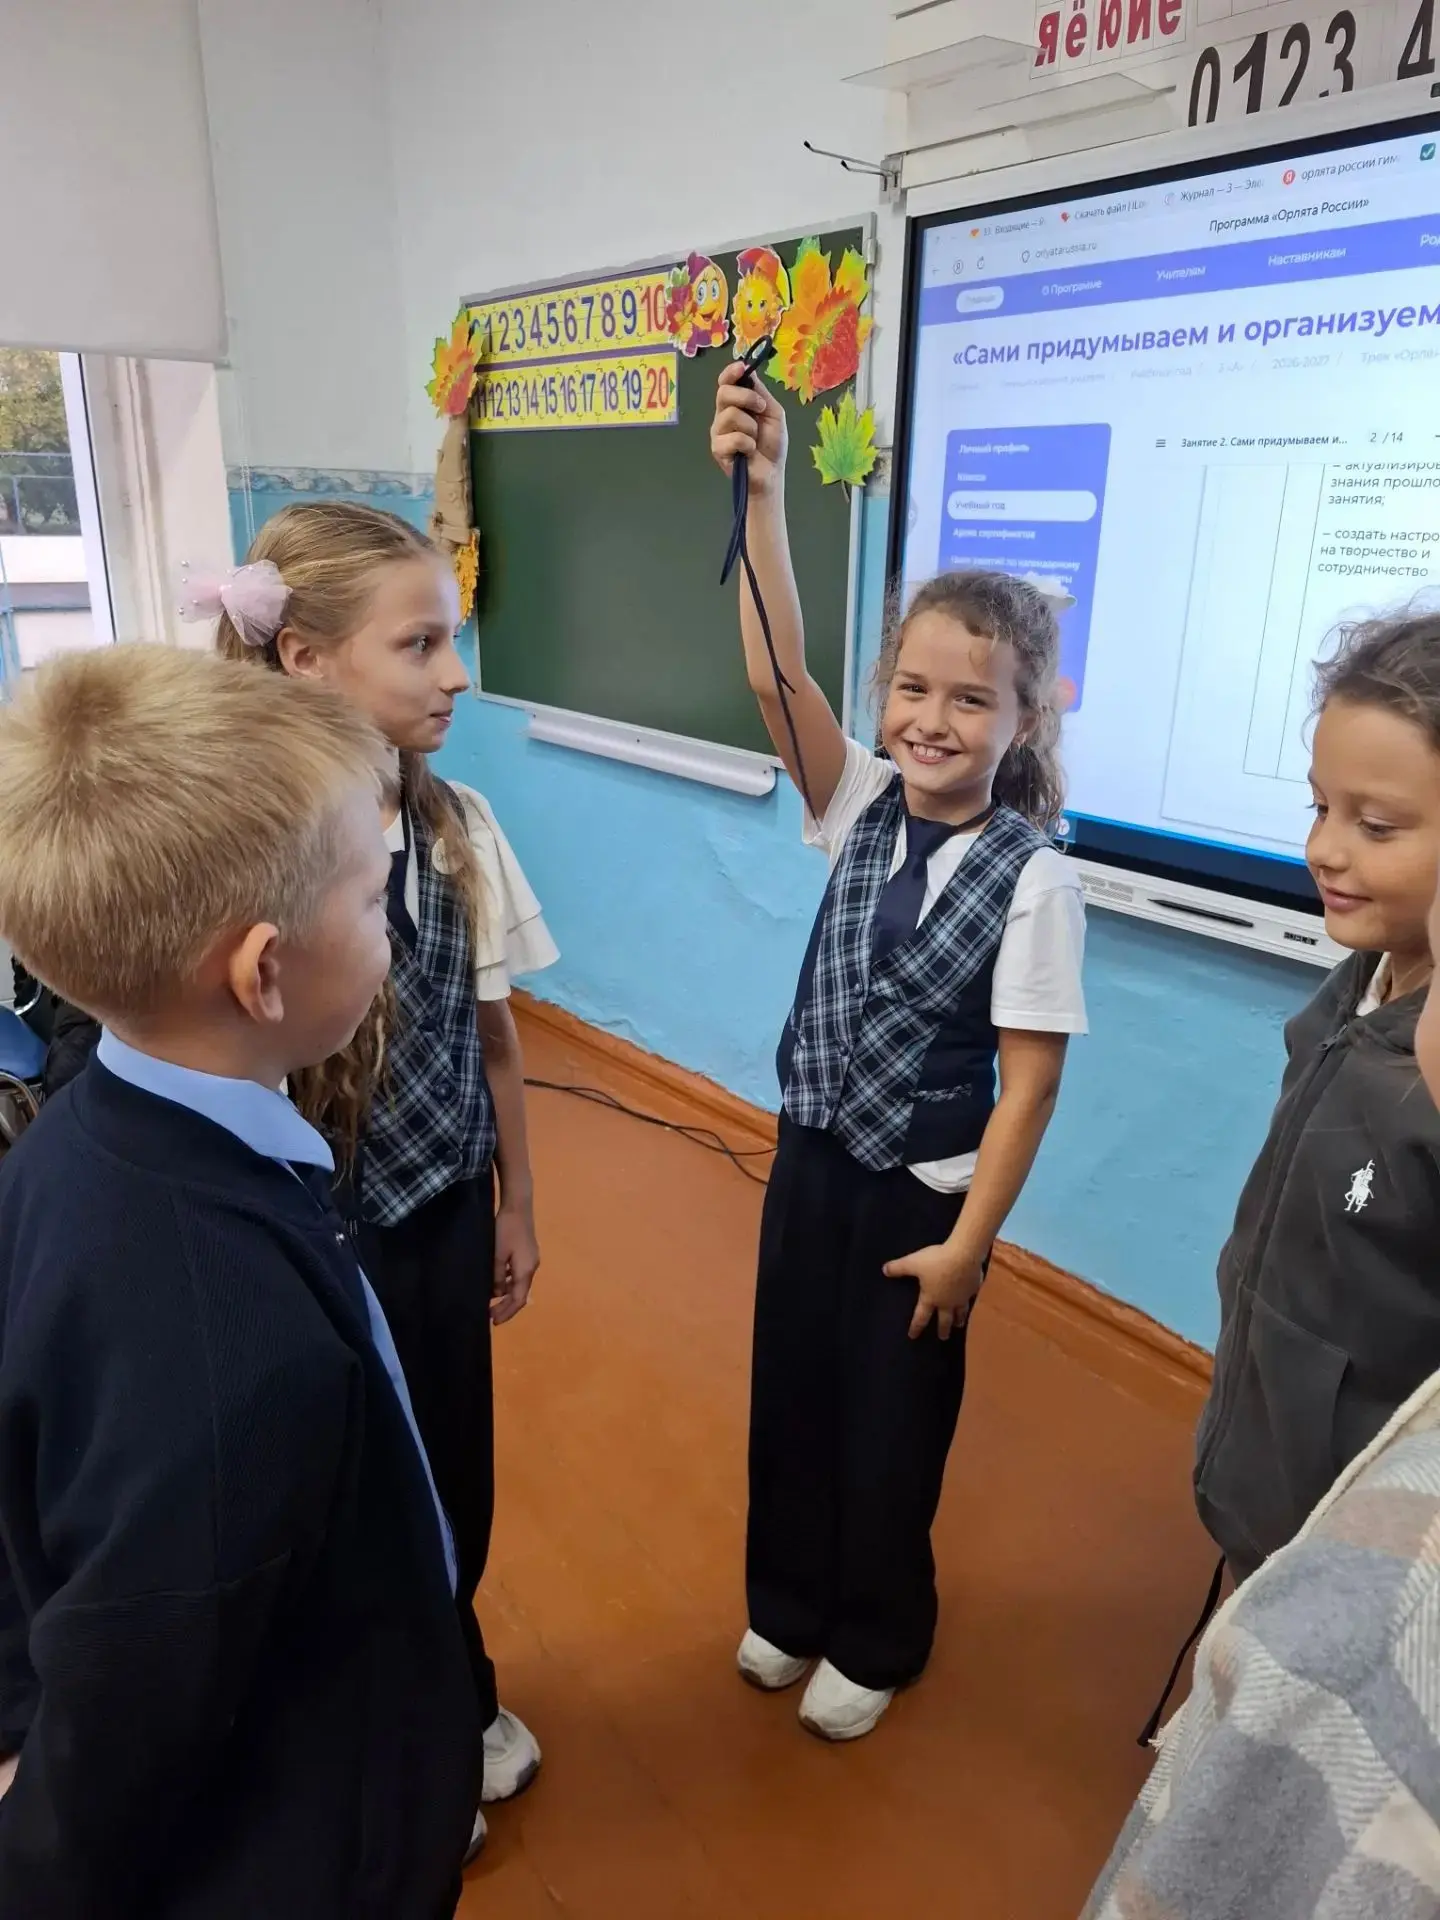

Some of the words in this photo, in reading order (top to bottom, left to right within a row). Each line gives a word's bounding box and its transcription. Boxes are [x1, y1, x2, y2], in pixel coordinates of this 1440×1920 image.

[1302, 166, 1336, 181] орлята
[1338, 159, 1376, 176] россии
[1181, 187, 1214, 203] Журнал
[1209, 214, 1269, 234] Программа
[1272, 205, 1319, 224] «Орлята
[1320, 198, 1370, 214] России»
[1268, 246, 1346, 267] Наставникам
[1050, 280, 1103, 296] Программе
[952, 343, 1020, 366] «Сами
[1027, 325, 1208, 365] придумываем
[1218, 323, 1236, 343] и
[1244, 303, 1440, 346] организуем
[646, 366, 669, 409] 20
[1181, 437, 1218, 449] Занятие
[1219, 437, 1228, 447] 2.
[1230, 436, 1255, 447] Сами
[1257, 434, 1329, 448] придумываем
[1370, 432, 1377, 443] 2
[1330, 477, 1380, 488] знания
[1382, 477, 1440, 491] прошло
[1328, 494, 1385, 507] занятия;
[1334, 528, 1387, 541] создать
[1390, 530, 1440, 544] настро
[1320, 546, 1336, 556] на
[1338, 546, 1418, 561] творчество
[1421, 549, 1431, 559] и
[1317, 562, 1428, 577] сотрудничество
